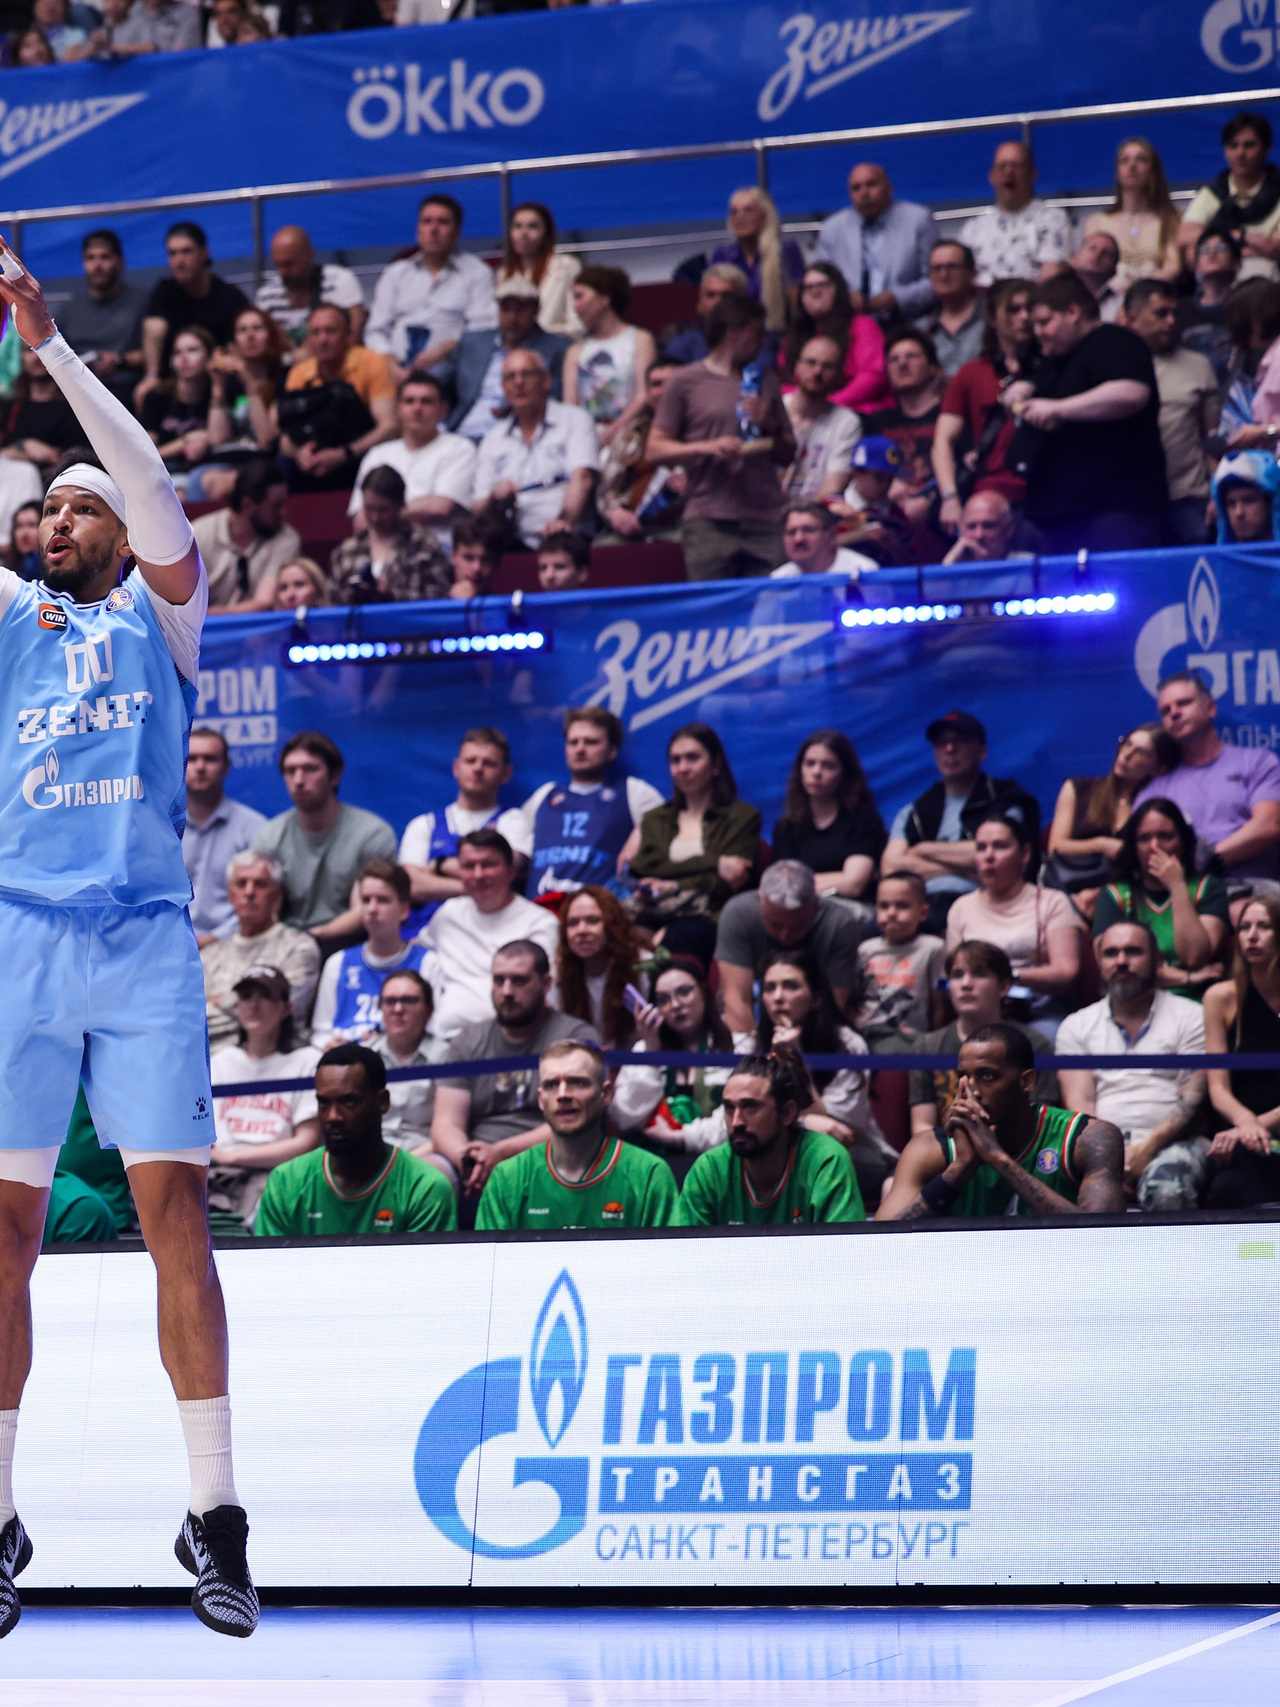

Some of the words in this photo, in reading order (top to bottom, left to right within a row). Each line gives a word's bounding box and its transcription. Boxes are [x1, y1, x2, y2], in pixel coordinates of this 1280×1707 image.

[64, 631, 114, 694] 00
[601, 1347, 977, 1445] ГАЗПРОМ
[612, 1462, 962, 1504] ТРАНСГАЗ
[595, 1521, 972, 1561] САНКТ-ПЕТЕРБУРГ
